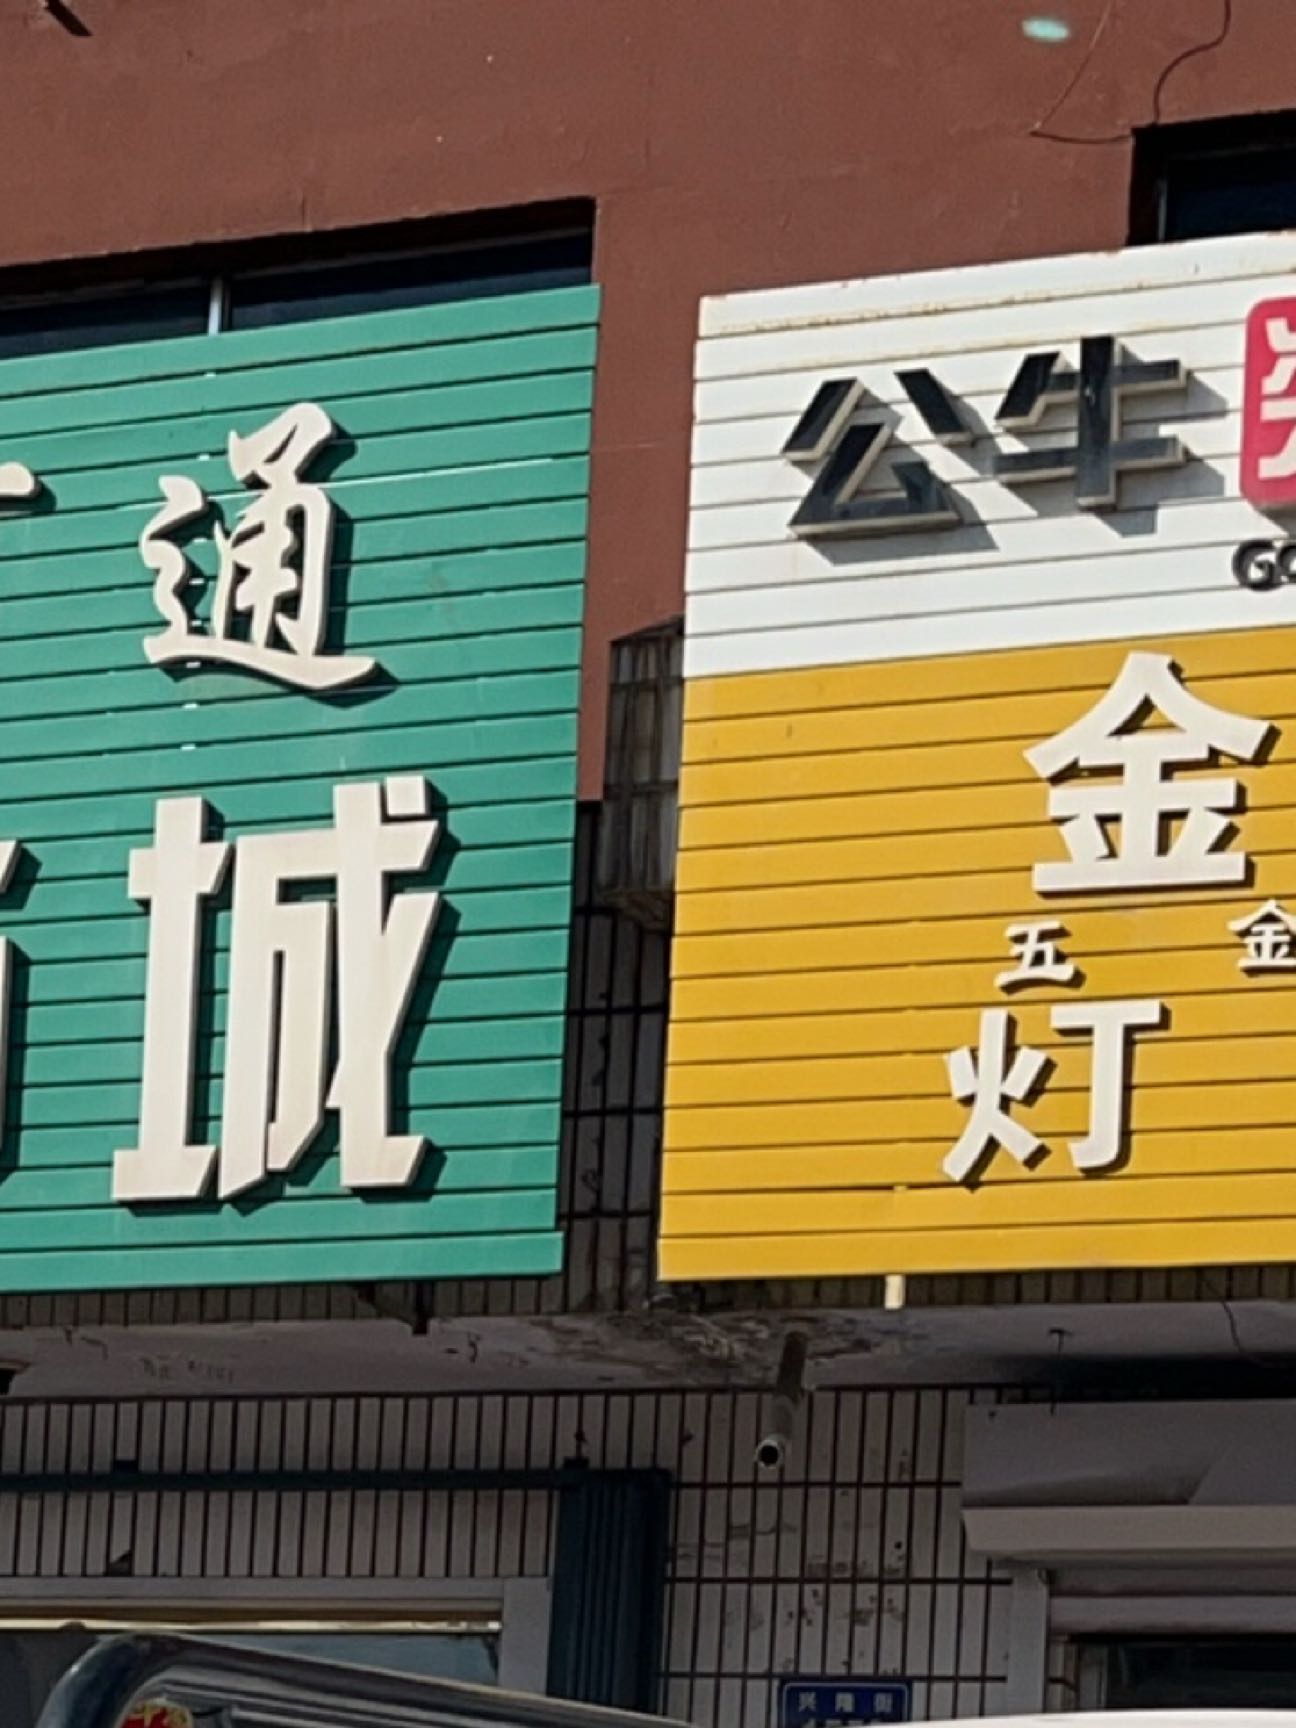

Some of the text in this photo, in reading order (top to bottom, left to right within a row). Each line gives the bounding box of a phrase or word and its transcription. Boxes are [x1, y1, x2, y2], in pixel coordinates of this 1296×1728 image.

[782, 334, 1186, 540] 公牛
[1021, 651, 1272, 892] 金
[940, 1000, 1163, 1183] 灯
